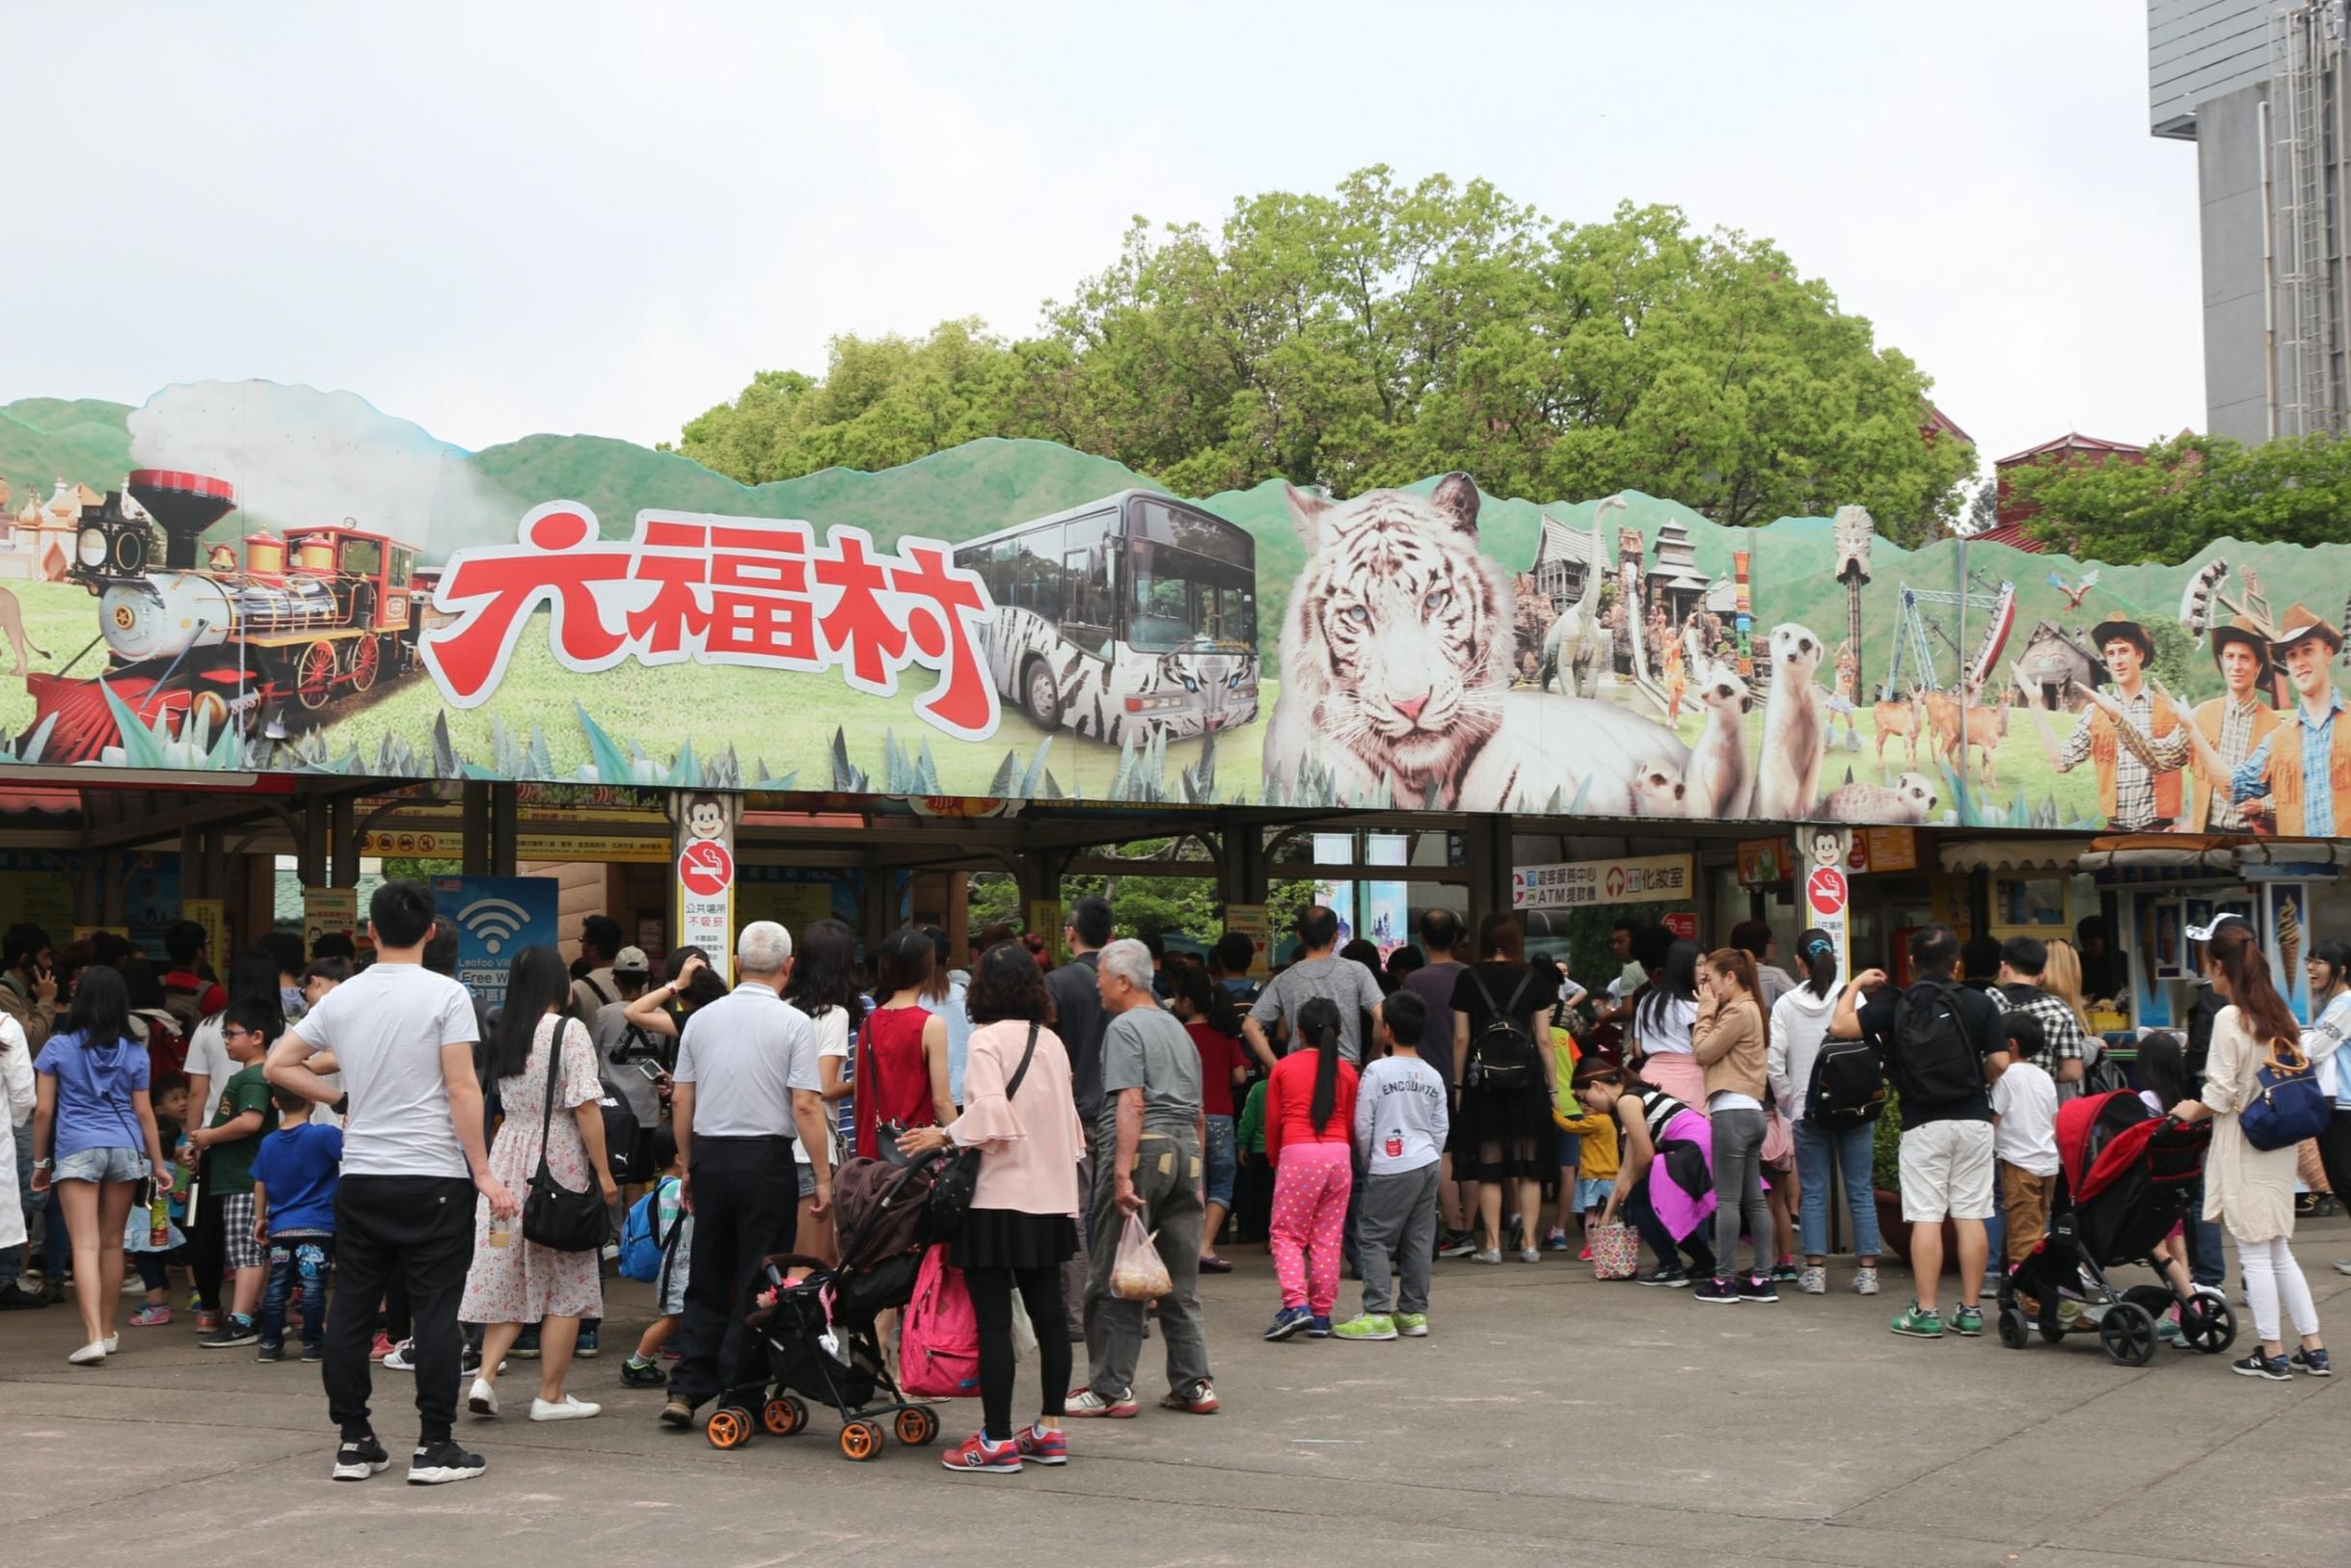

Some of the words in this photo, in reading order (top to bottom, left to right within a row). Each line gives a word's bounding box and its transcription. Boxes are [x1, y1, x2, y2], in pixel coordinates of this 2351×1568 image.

[424, 507, 995, 735] 六福村
[496, 959, 511, 967] Vill
[463, 972, 492, 984] Free
